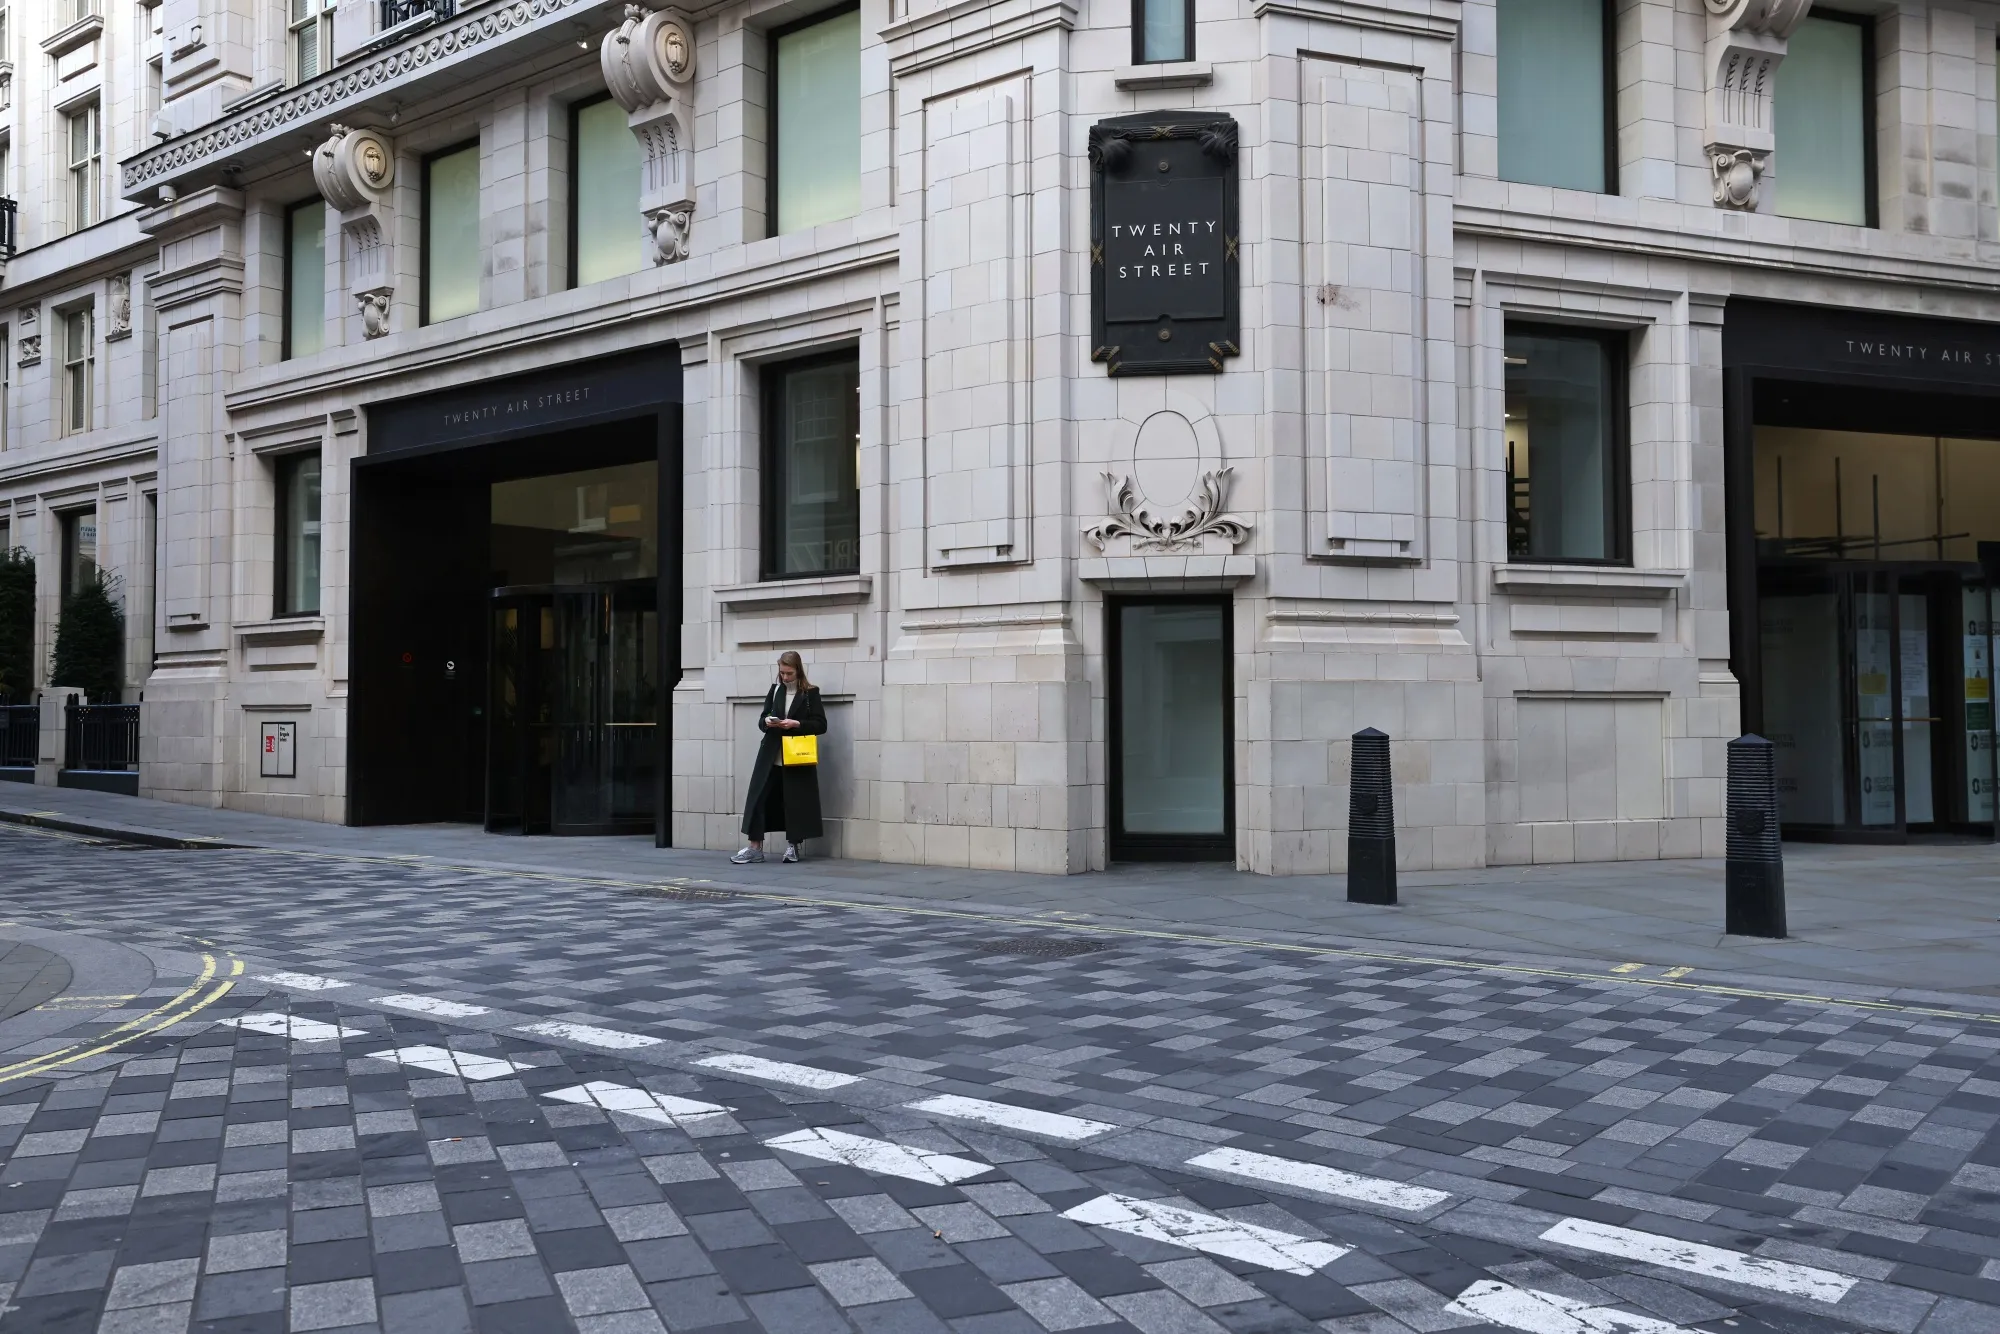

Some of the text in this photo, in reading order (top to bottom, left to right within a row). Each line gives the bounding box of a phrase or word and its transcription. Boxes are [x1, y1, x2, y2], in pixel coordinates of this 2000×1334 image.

[1112, 221, 1216, 238] TWENTY
[1144, 244, 1184, 257] AIR
[1119, 263, 1209, 278] STREET
[1846, 341, 1927, 359] TWENTY
[1941, 349, 1972, 363] AIR
[444, 387, 590, 426] TWENTY AIR STREET
